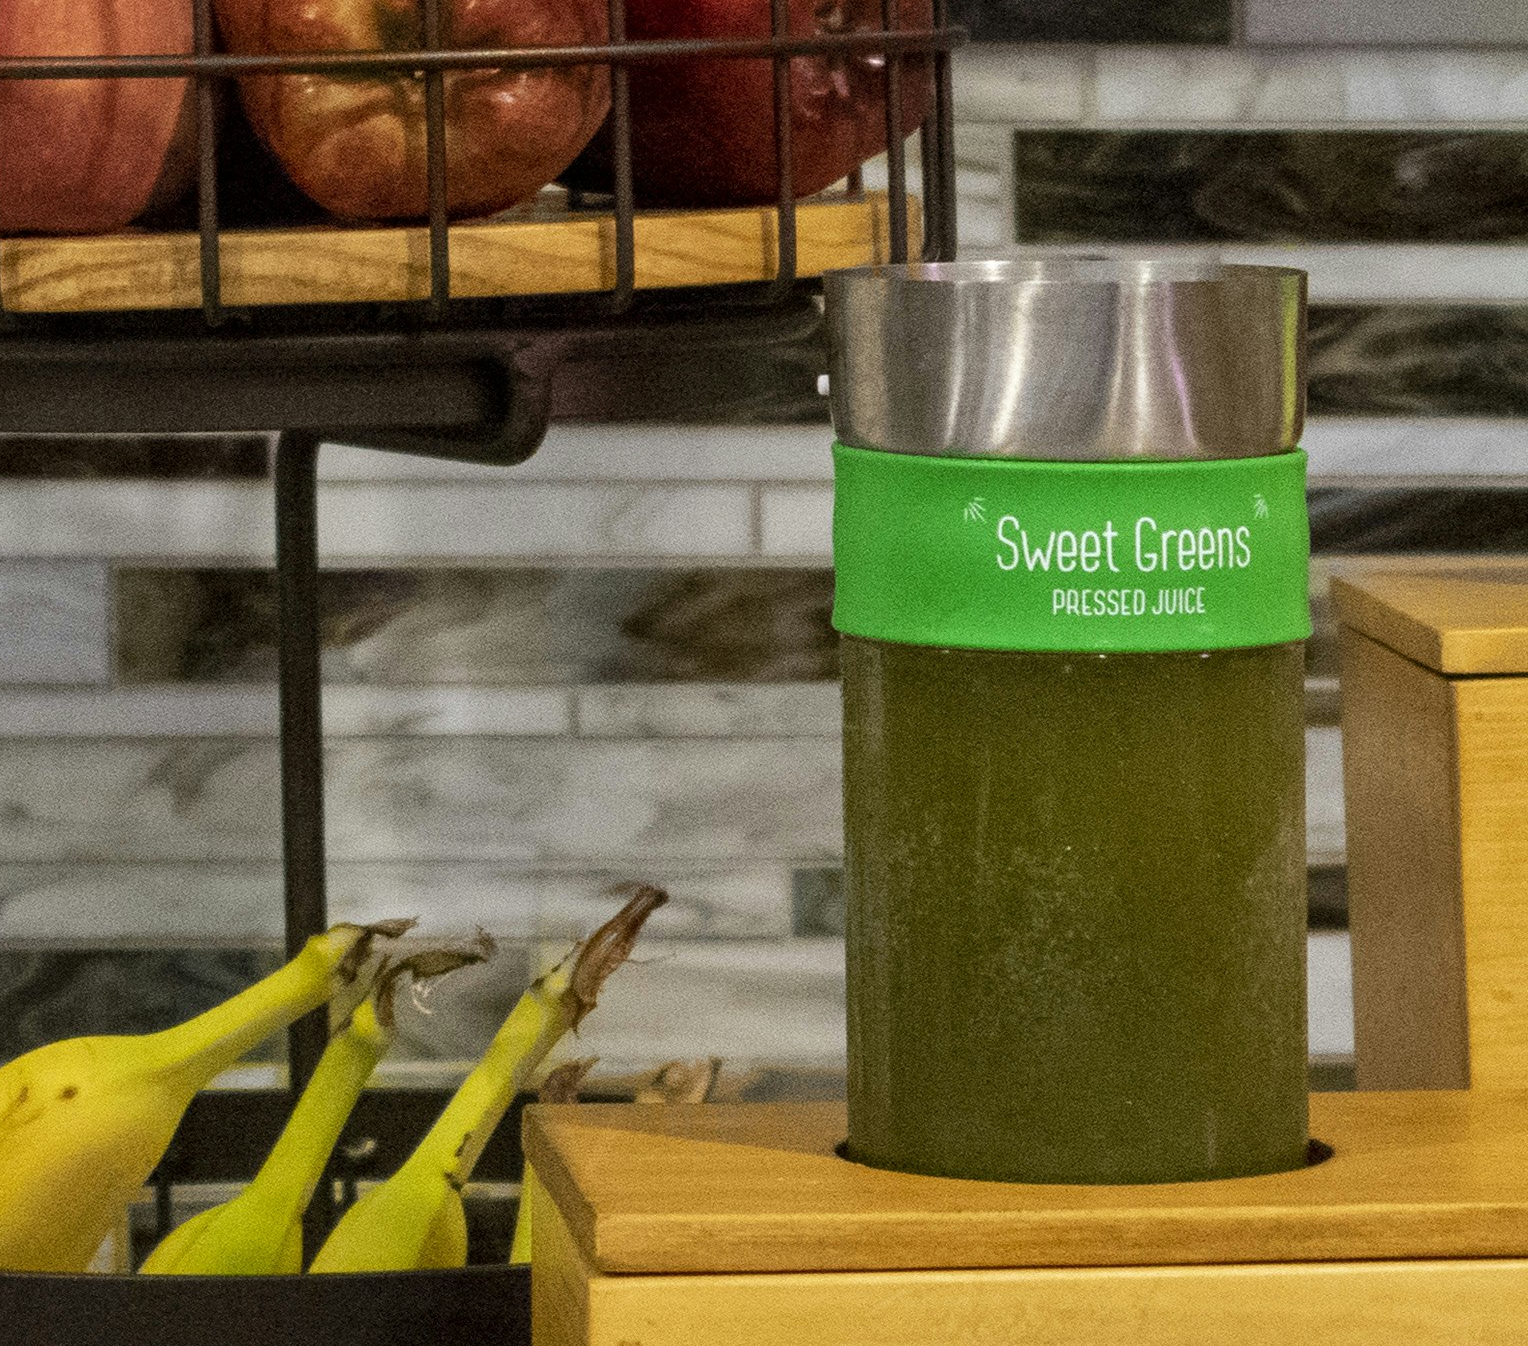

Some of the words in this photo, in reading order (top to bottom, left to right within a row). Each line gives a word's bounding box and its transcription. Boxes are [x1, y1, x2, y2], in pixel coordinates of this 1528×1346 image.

[996, 515, 1120, 572] Sweet
[1134, 516, 1251, 572] Greens
[1052, 588, 1145, 616] PRESSED
[1152, 587, 1206, 615] JUICE
